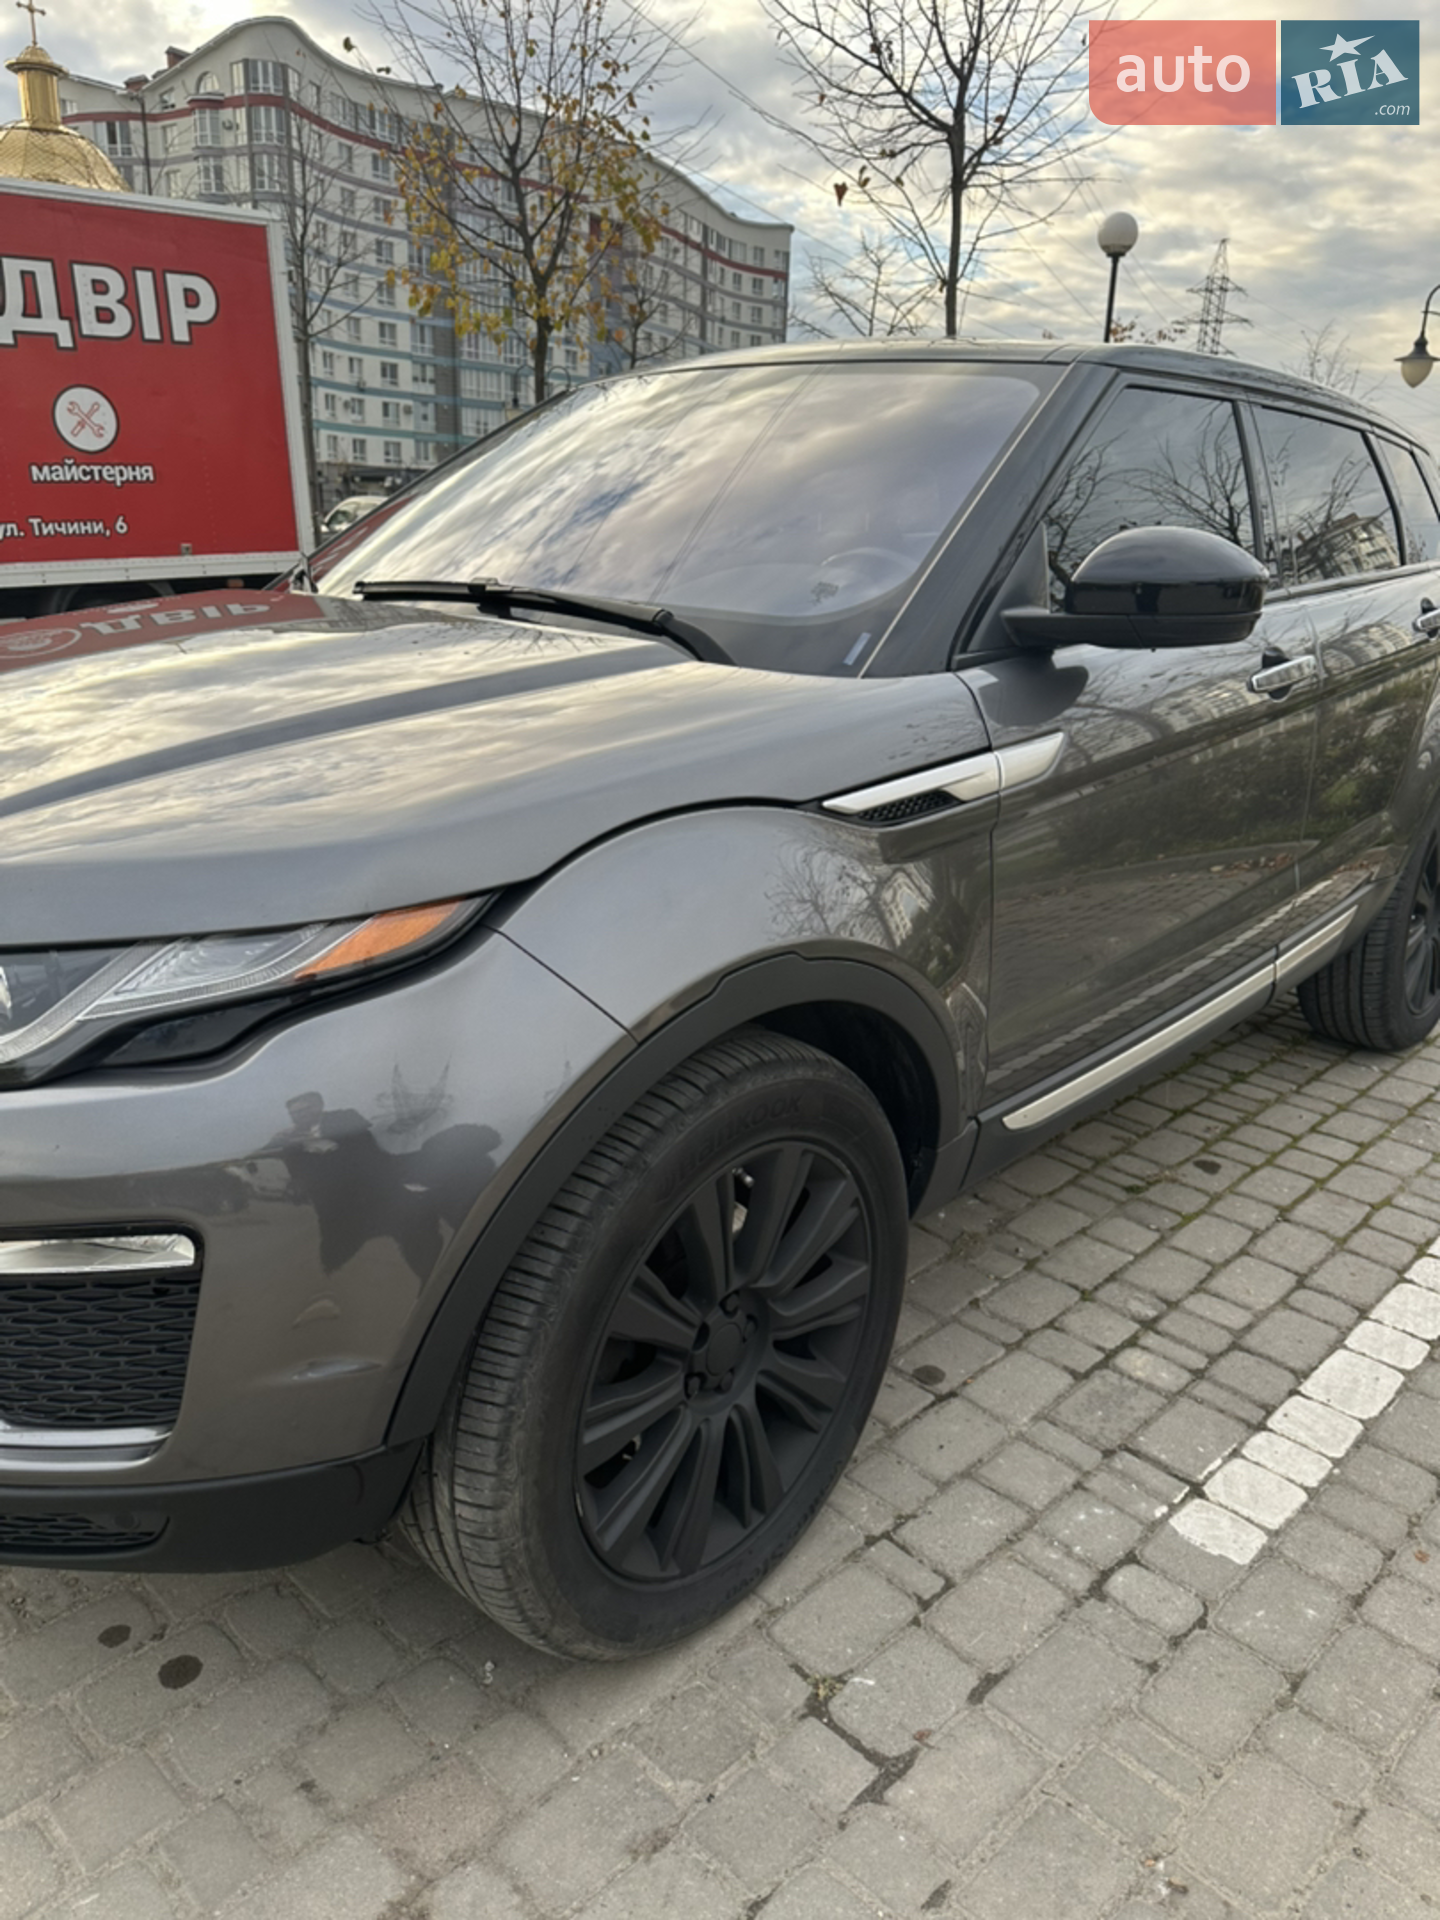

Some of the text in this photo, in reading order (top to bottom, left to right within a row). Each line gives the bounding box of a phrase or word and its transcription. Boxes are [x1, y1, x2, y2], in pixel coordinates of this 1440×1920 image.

[0, 255, 219, 351] ДВІР
[29, 458, 155, 487] майстерня
[27, 517, 111, 538] Тичини,
[114, 515, 129, 535] 6
